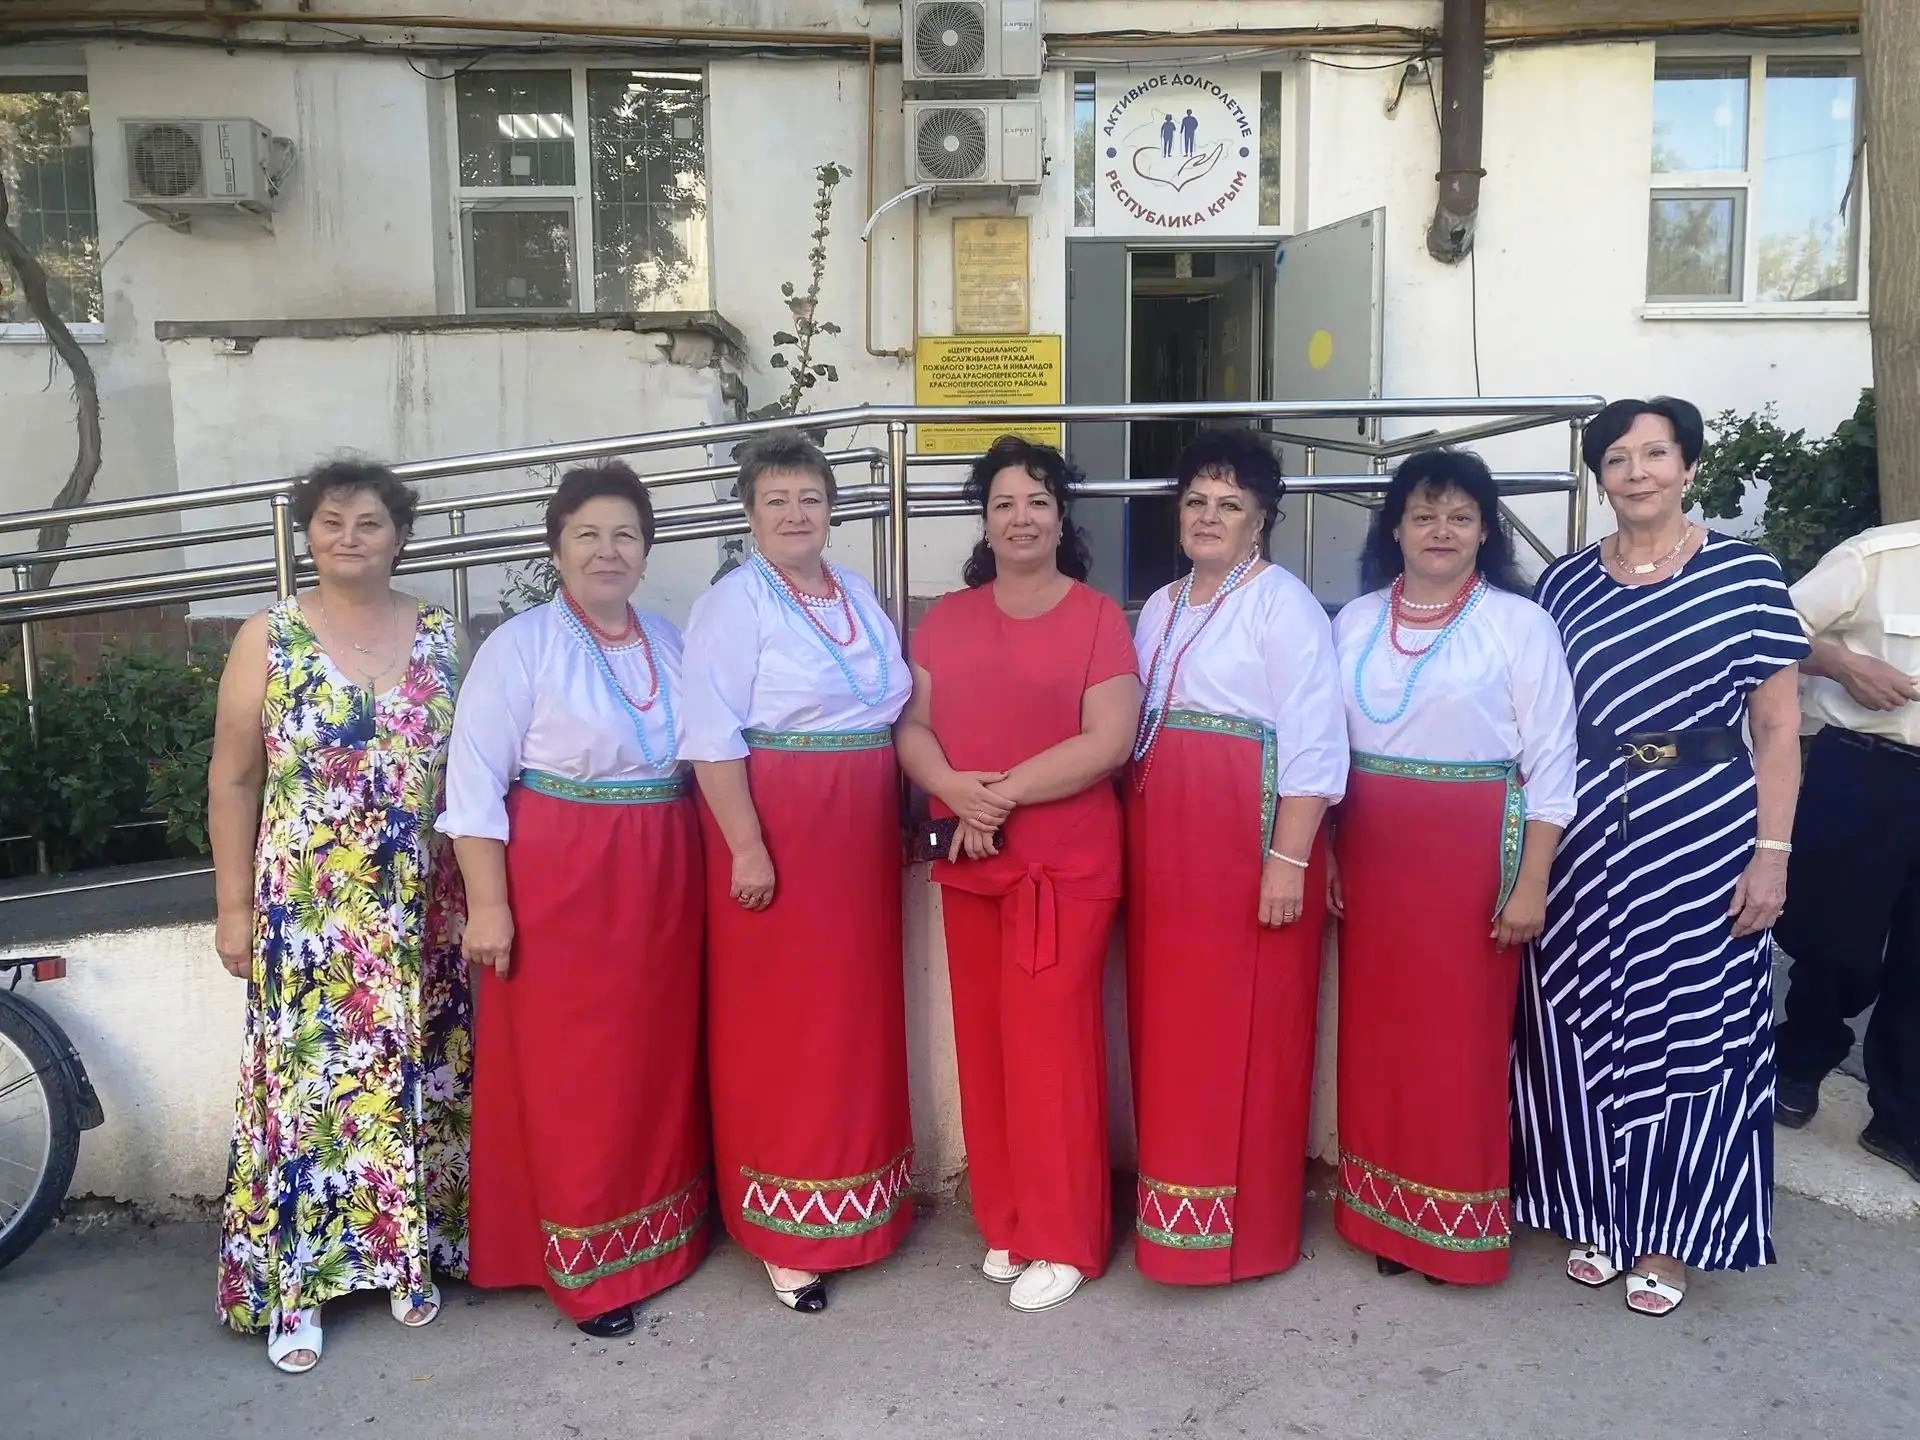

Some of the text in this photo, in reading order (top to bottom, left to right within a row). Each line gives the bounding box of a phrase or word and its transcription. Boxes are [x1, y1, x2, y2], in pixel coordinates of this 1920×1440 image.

[1103, 73, 1252, 138] АКТИВНОЕ ДОЛГОЛЕТИЕ
[1105, 169, 1247, 228] РЕСПУБЛИКА КРЫМ
